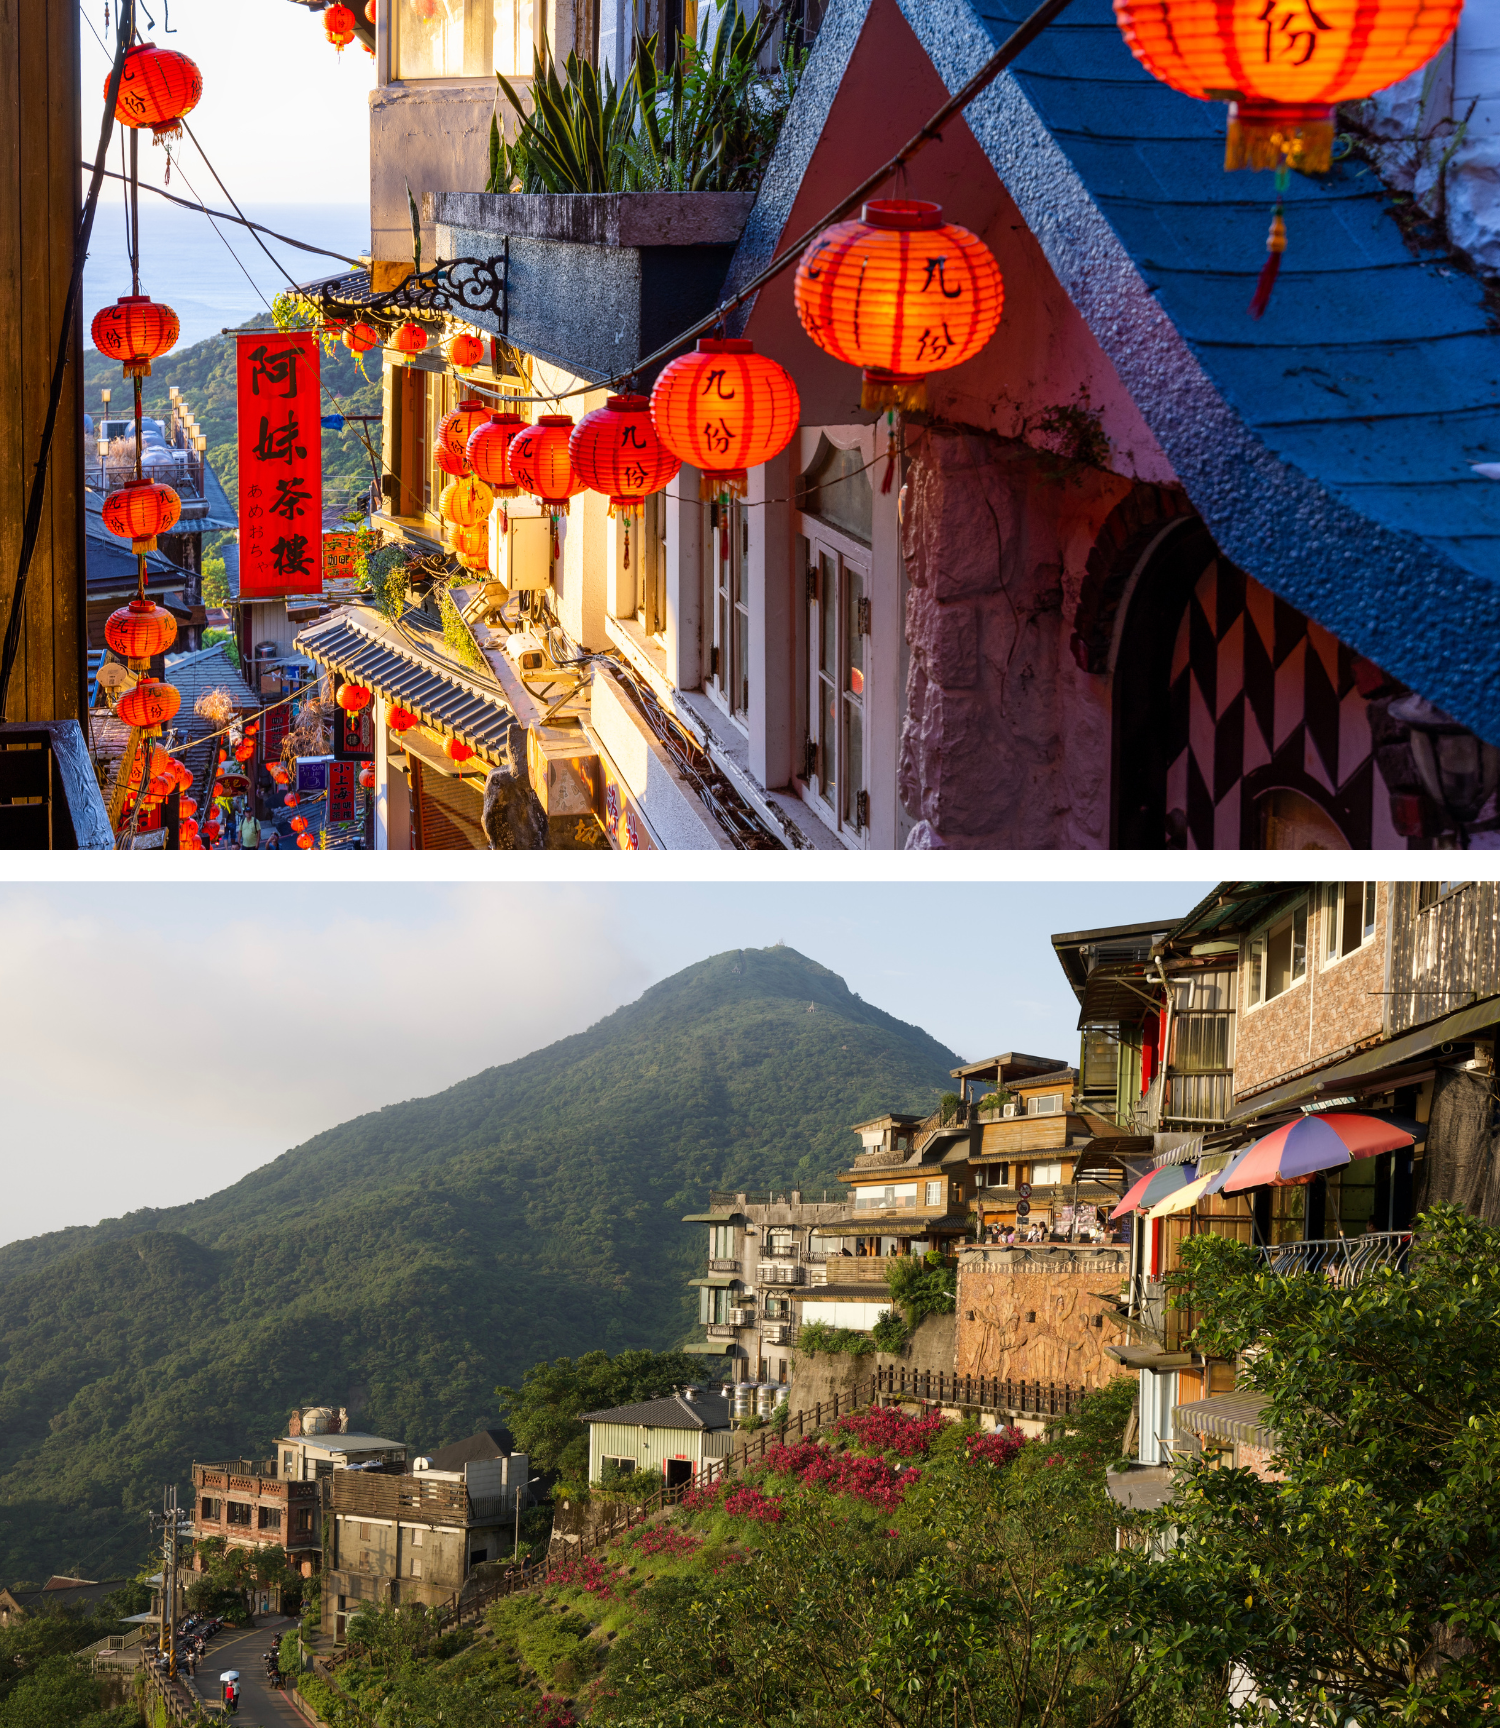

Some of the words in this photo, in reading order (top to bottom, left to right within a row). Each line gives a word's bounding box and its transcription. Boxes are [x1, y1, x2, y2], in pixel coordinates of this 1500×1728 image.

[105, 305, 123, 348] 九份
[917, 255, 962, 364] 九份
[450, 418, 464, 454] 九份
[702, 369, 736, 454] 九份
[248, 345, 315, 576] 阿妹茶樓
[516, 438, 535, 490] 九份
[622, 425, 649, 489] 九份
[109, 494, 125, 533] 九份
[247, 484, 269, 574] あめおちゃ
[333, 763, 351, 800] 小上海
